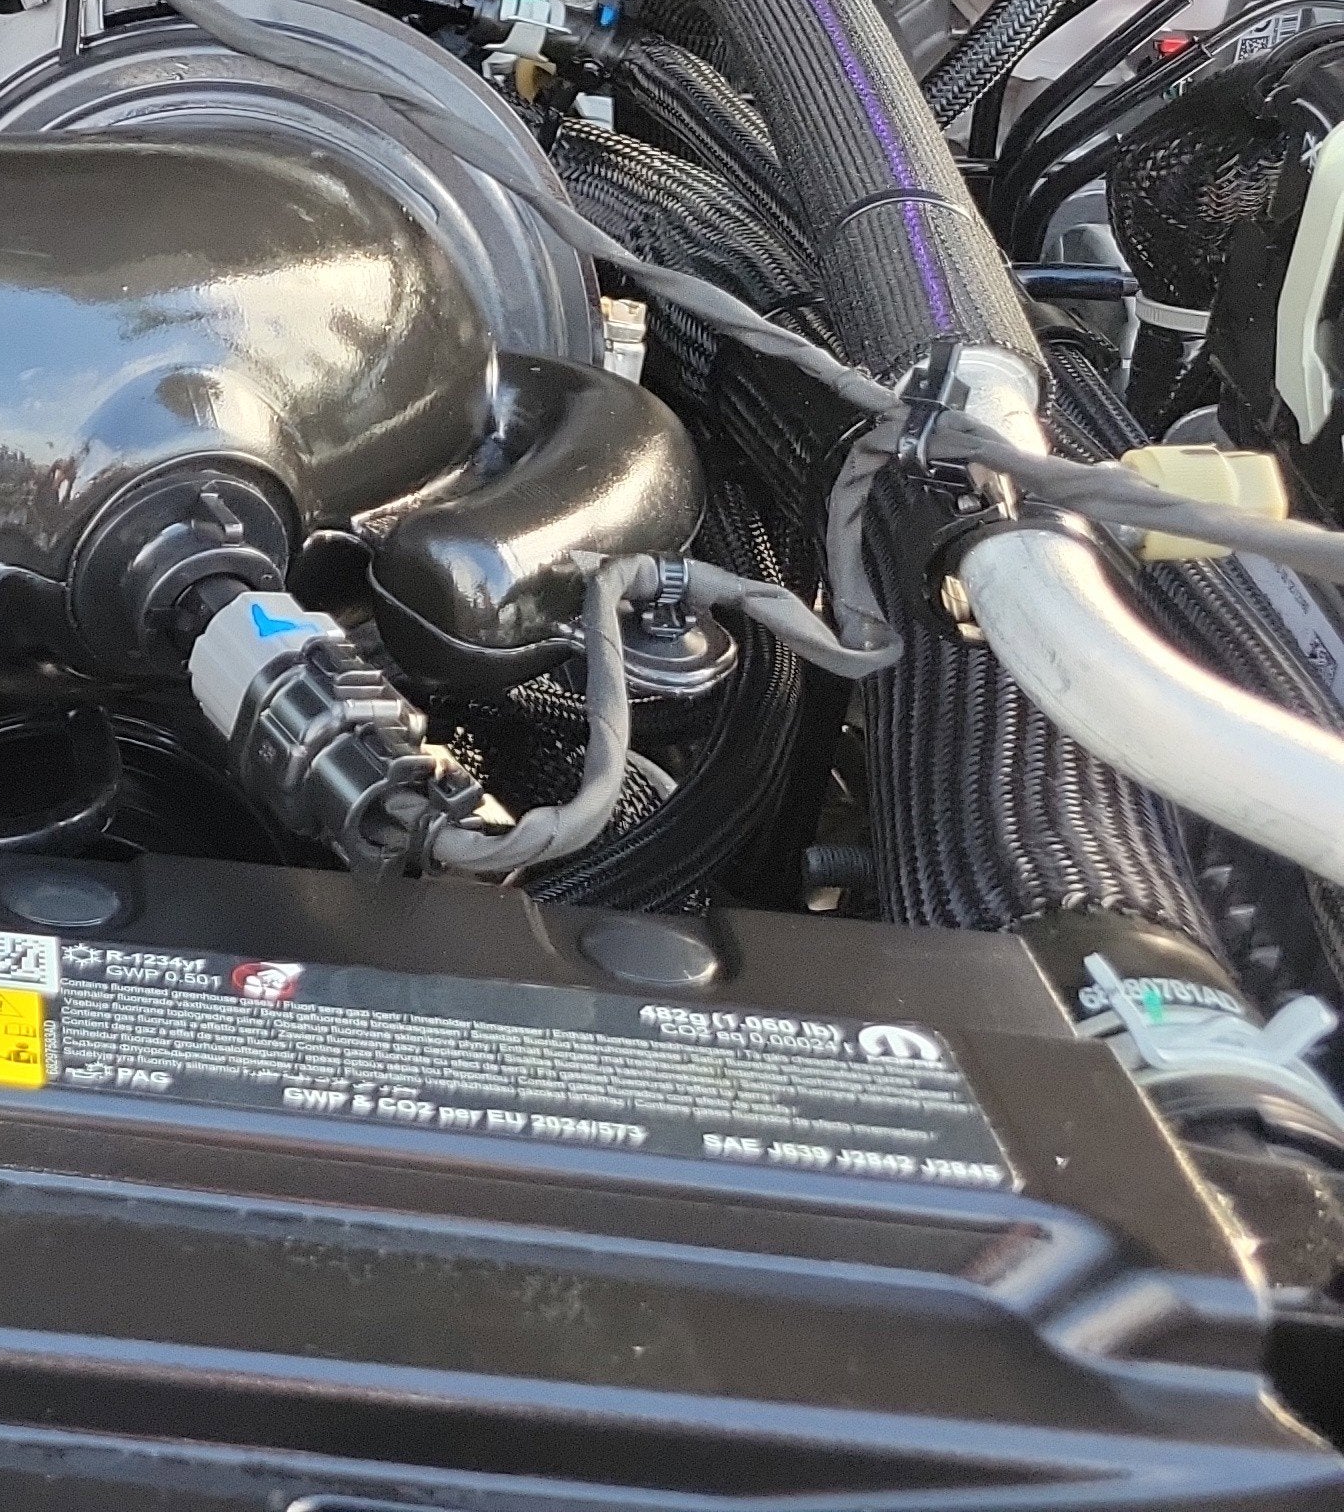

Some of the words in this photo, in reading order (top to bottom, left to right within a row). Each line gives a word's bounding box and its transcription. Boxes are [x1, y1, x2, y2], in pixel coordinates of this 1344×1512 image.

[104, 948, 208, 972] R-1234yf
[105, 963, 160, 980] GWP
[164, 970, 222, 987] 0.501
[58, 977, 108, 990] Contains
[109, 983, 168, 996] fluorinated
[170, 989, 237, 1004] greenhouse
[60, 1006, 111, 1019] Contiene
[60, 1016, 109, 1029] Contient
[639, 1004, 709, 1026] 482g
[660, 1022, 711, 1038] CO2
[715, 1030, 747, 1045] eq
[115, 1066, 170, 1084] PAG
[282, 1085, 347, 1105] GWP
[352, 1093, 374, 1108] &
[376, 1095, 436, 1115] CO2
[437, 1105, 485, 1123] per
[485, 1108, 528, 1126] EU
[701, 1132, 762, 1153] SAE
[765, 1139, 831, 1161] J639
